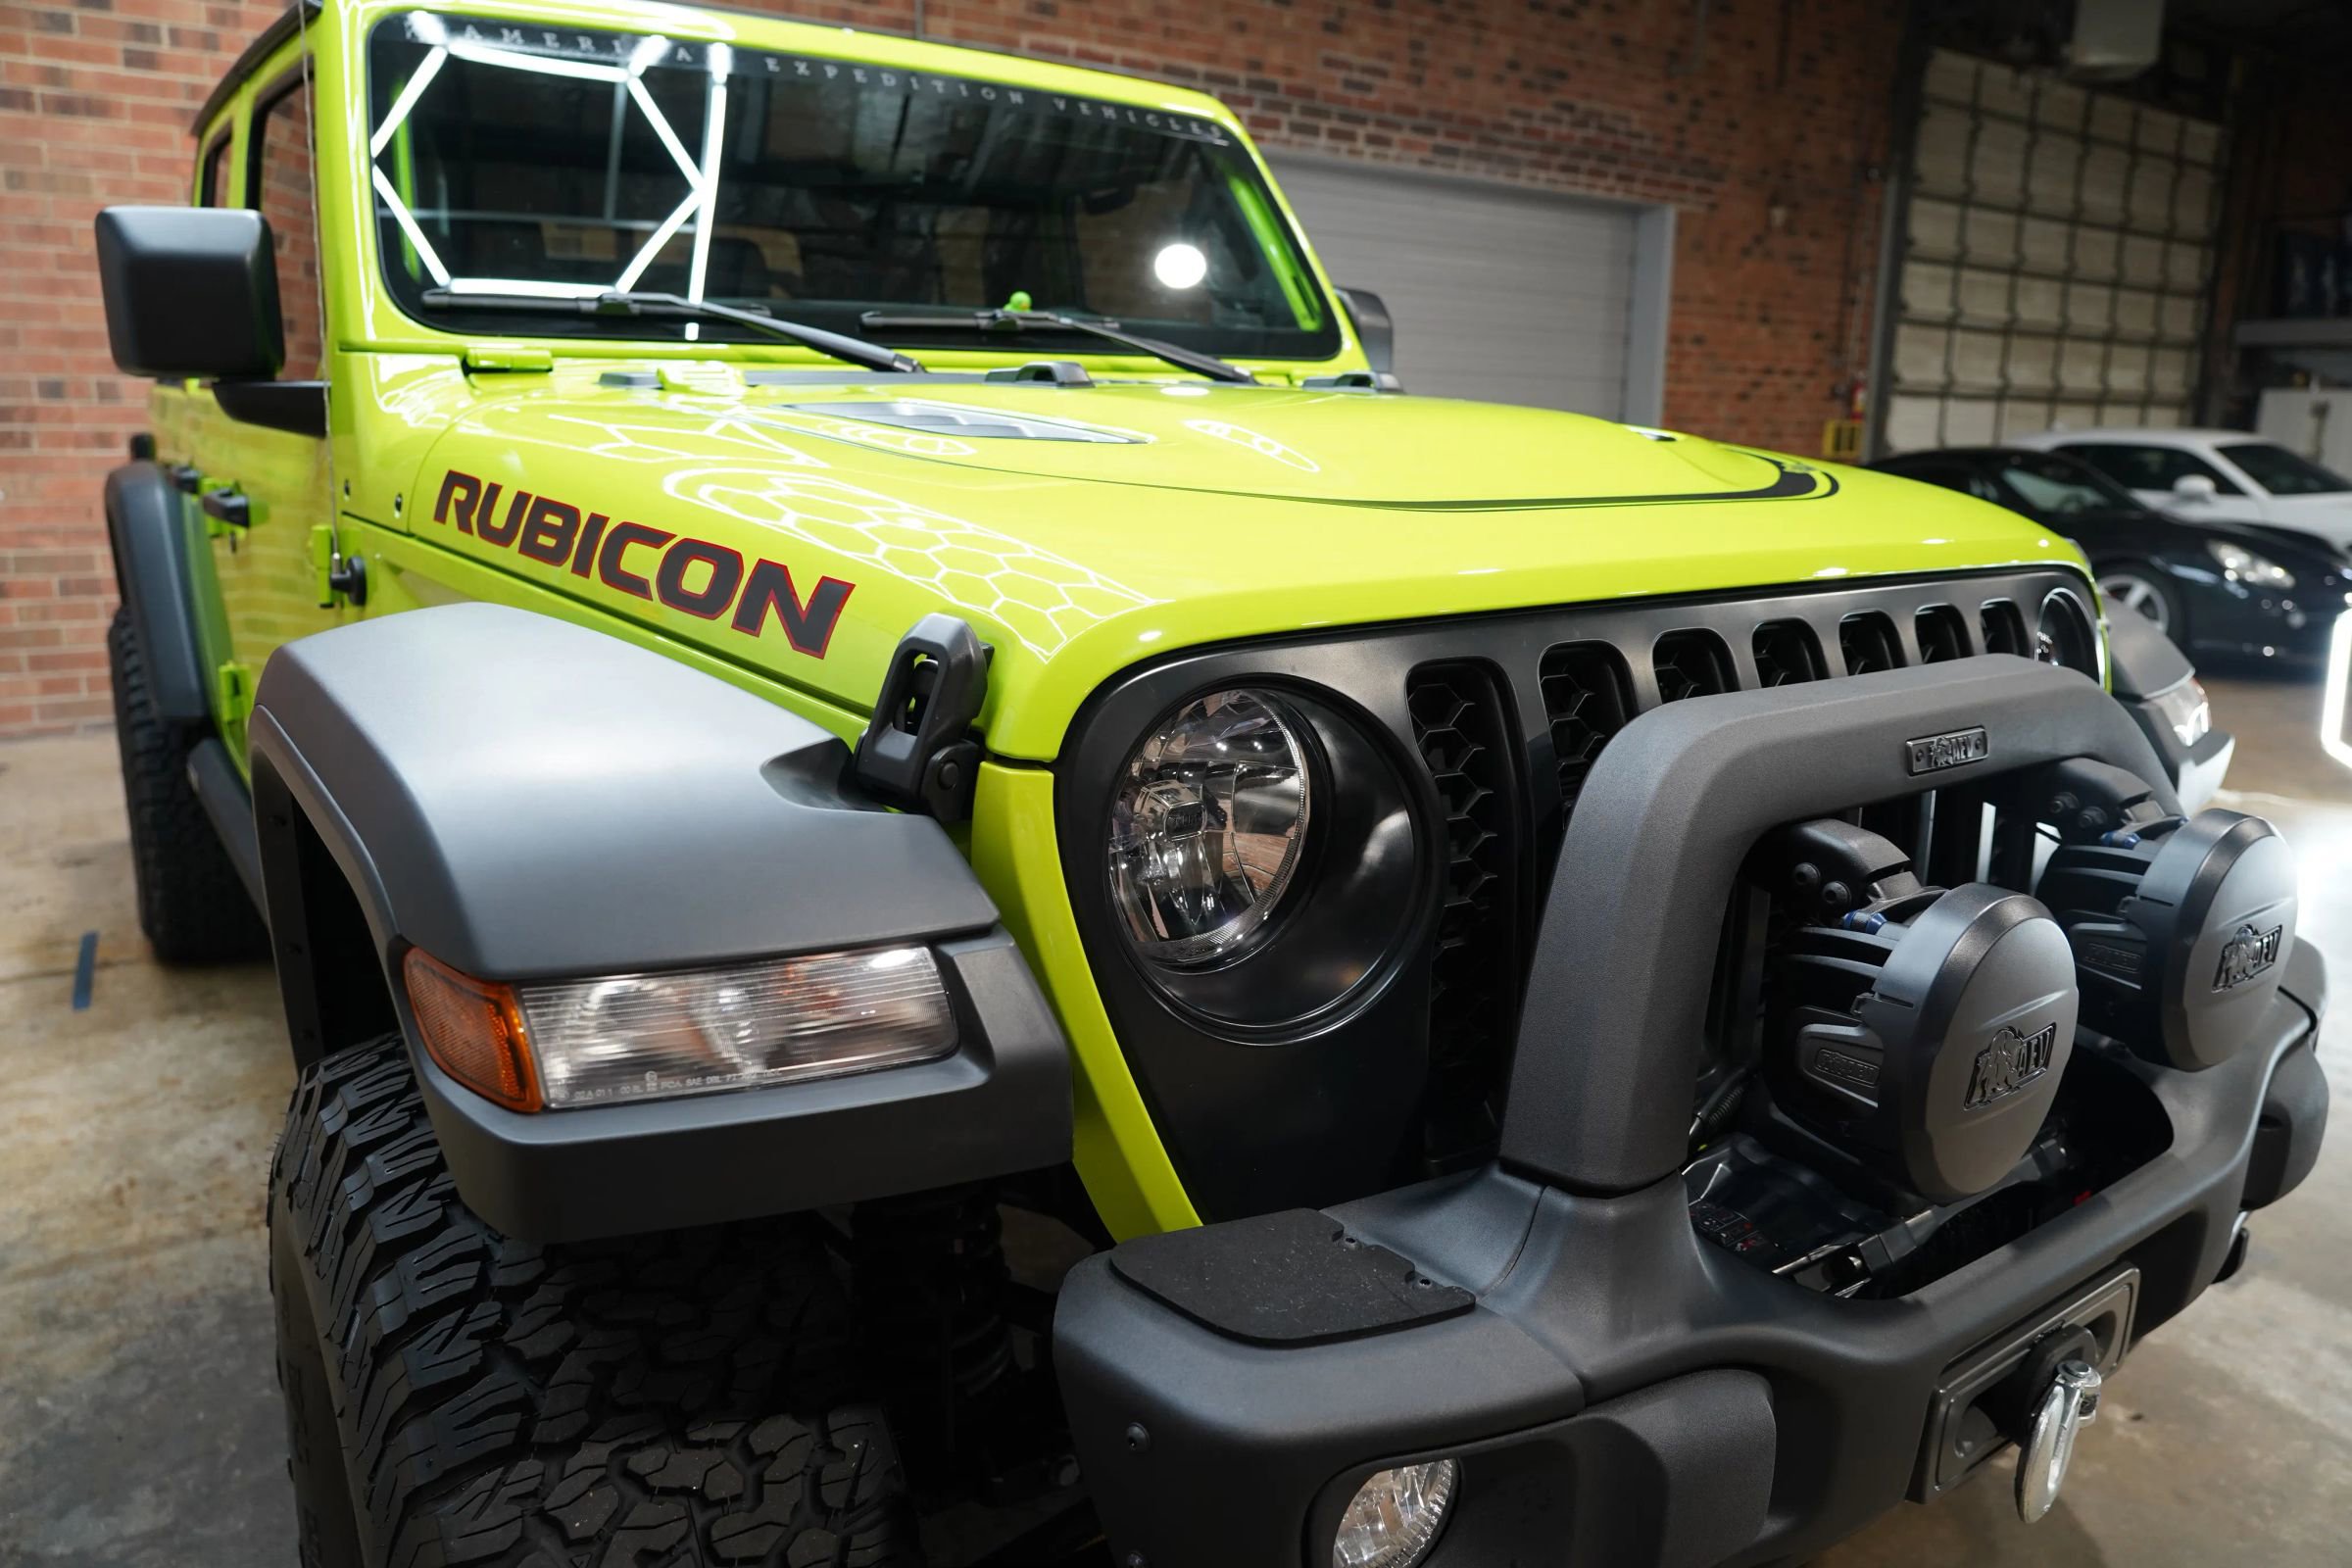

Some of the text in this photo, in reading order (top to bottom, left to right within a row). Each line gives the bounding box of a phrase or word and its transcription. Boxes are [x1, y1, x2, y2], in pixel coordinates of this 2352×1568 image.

[764, 56, 1024, 106] EXPEDITION
[1054, 97, 1223, 139] VEHICLES
[433, 469, 857, 660] RUBICON
[2018, 1031, 2051, 1075] AEV
